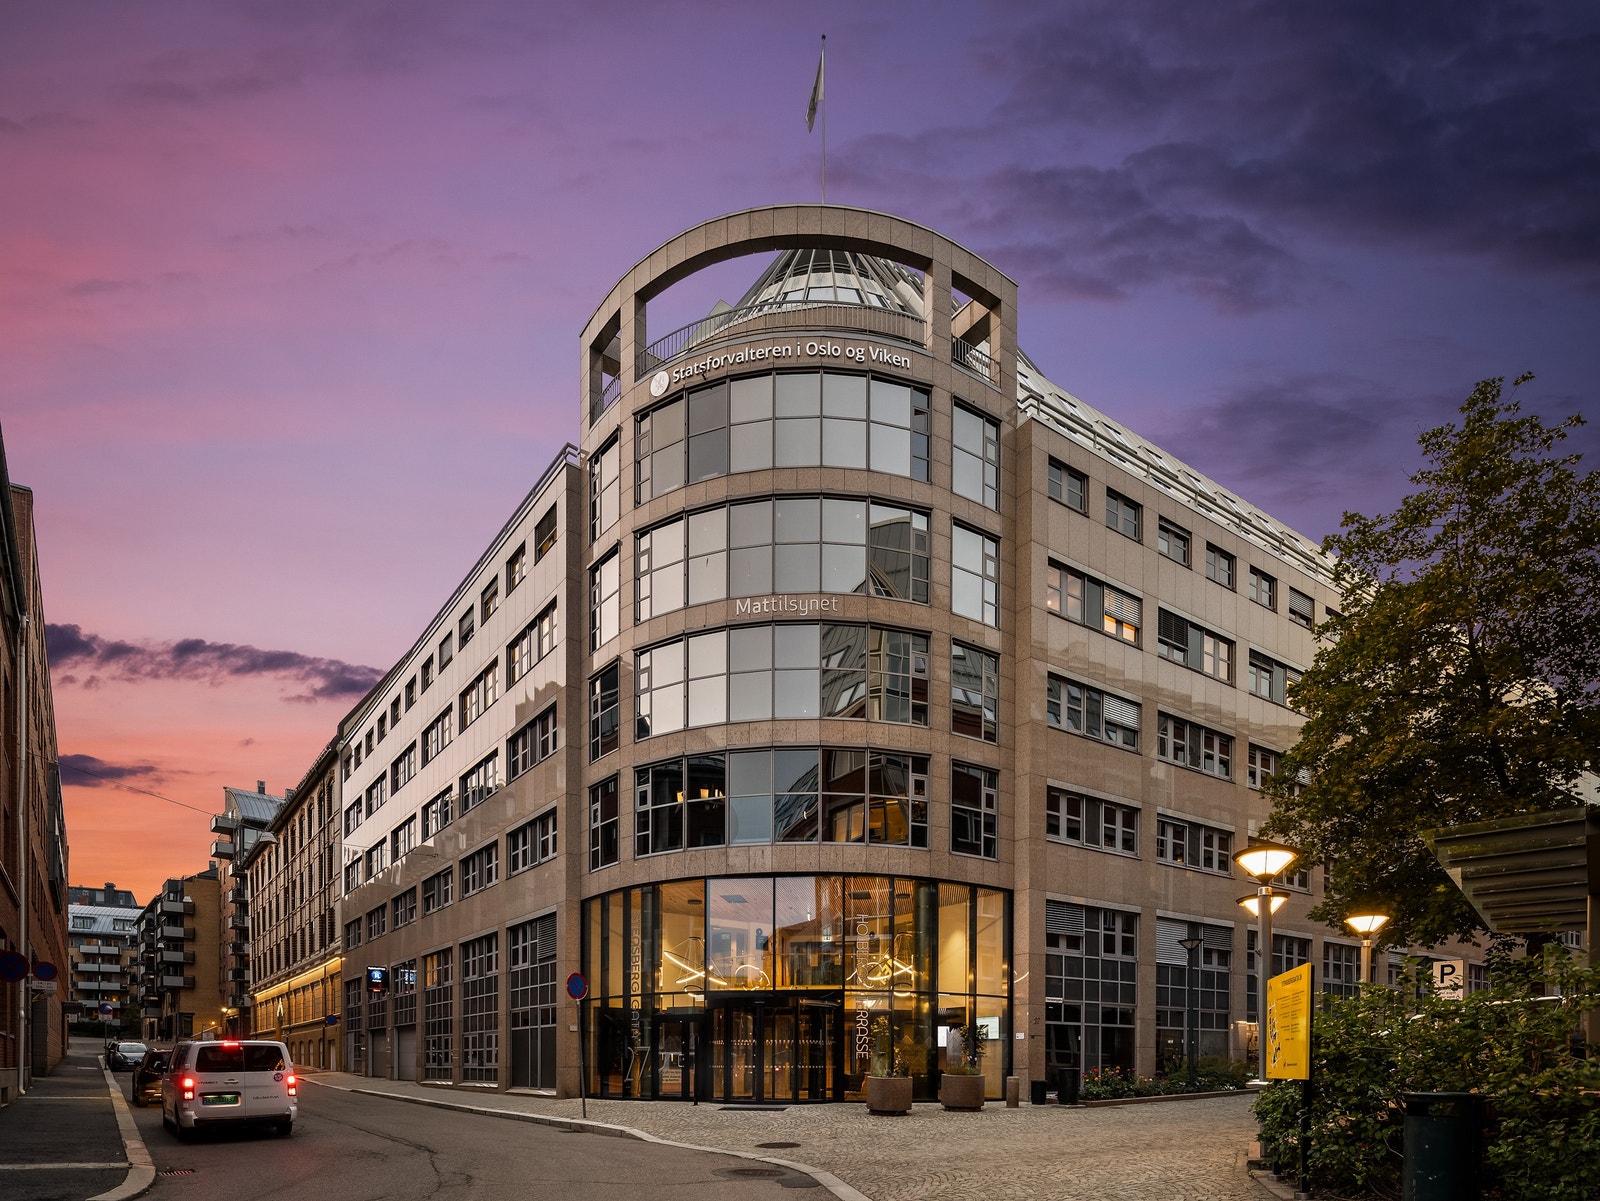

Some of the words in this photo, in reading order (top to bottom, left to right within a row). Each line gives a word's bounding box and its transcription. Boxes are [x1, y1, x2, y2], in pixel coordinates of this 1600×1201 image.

[672, 341, 792, 383] Statsforvalteren
[796, 341, 801, 357] i
[806, 341, 841, 357] Oslo
[846, 346, 865, 362] og
[869, 346, 911, 369] Viken
[736, 595, 838, 616] Mattilsynet
[1440, 964, 1456, 984] P
[624, 1046, 651, 1083] 27
